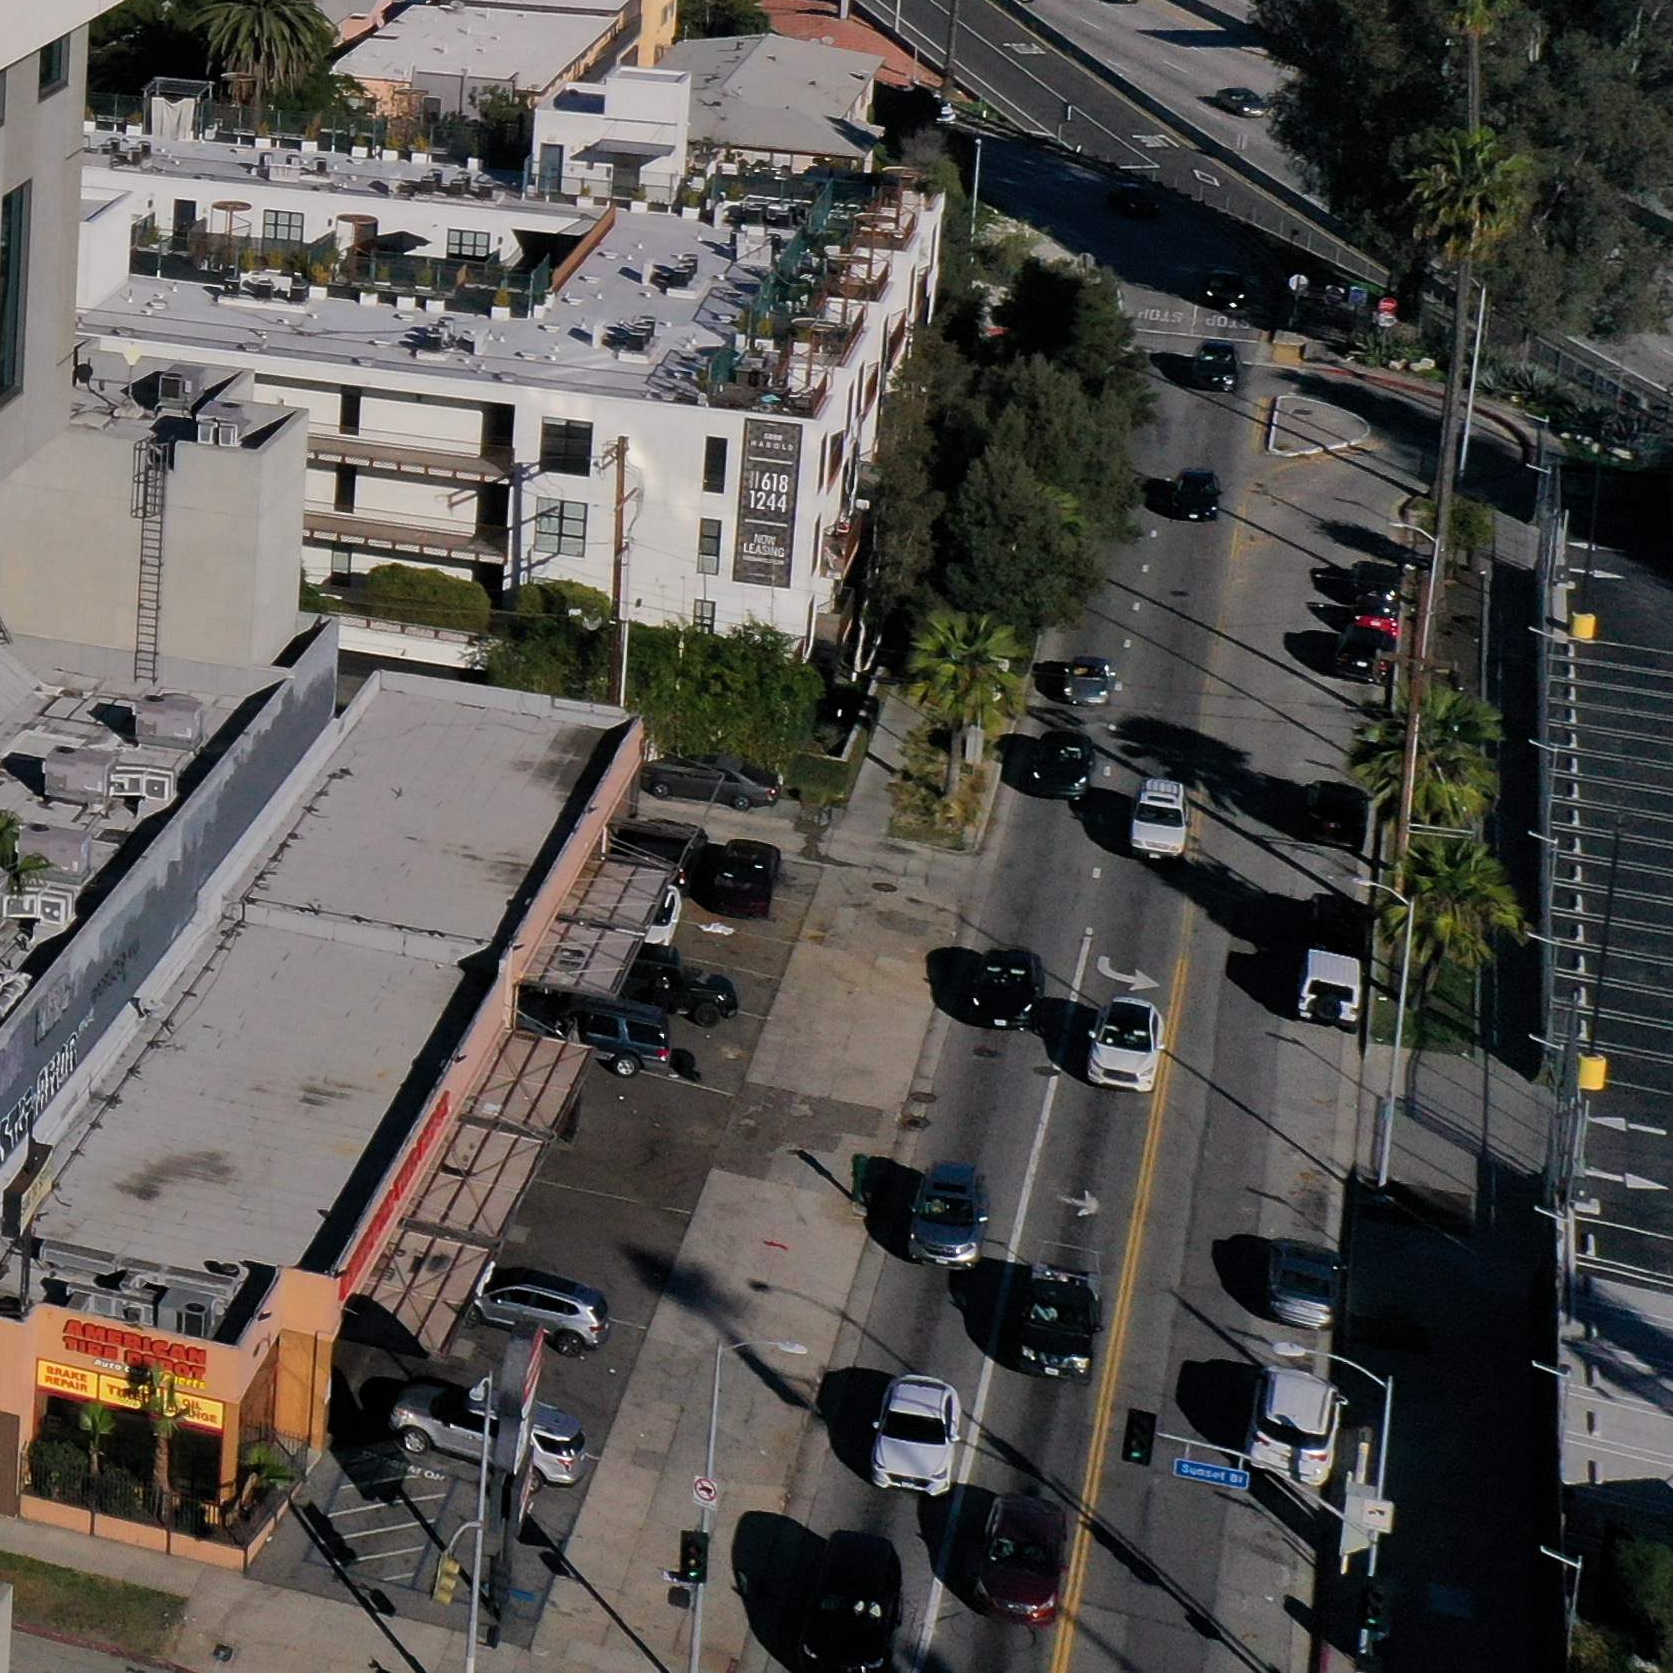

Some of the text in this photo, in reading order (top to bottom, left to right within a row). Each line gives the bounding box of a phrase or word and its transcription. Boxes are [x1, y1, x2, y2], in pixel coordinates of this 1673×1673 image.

[1137, 308, 1184, 323] STOP
[761, 472, 789, 494] 618
[749, 490, 787, 513] 1244
[754, 533, 776, 546] NOW
[743, 542, 785, 558] LEASING
[62, 1319, 207, 1364] AMERICAN
[62, 1335, 118, 1361] TIRE
[123, 1350, 207, 1380] DEPOT
[46, 1365, 88, 1382] BRAKE
[45, 1375, 88, 1393] REPAIR
[181, 1398, 202, 1411] OIL
[1181, 1463, 1226, 1481] Sunset
